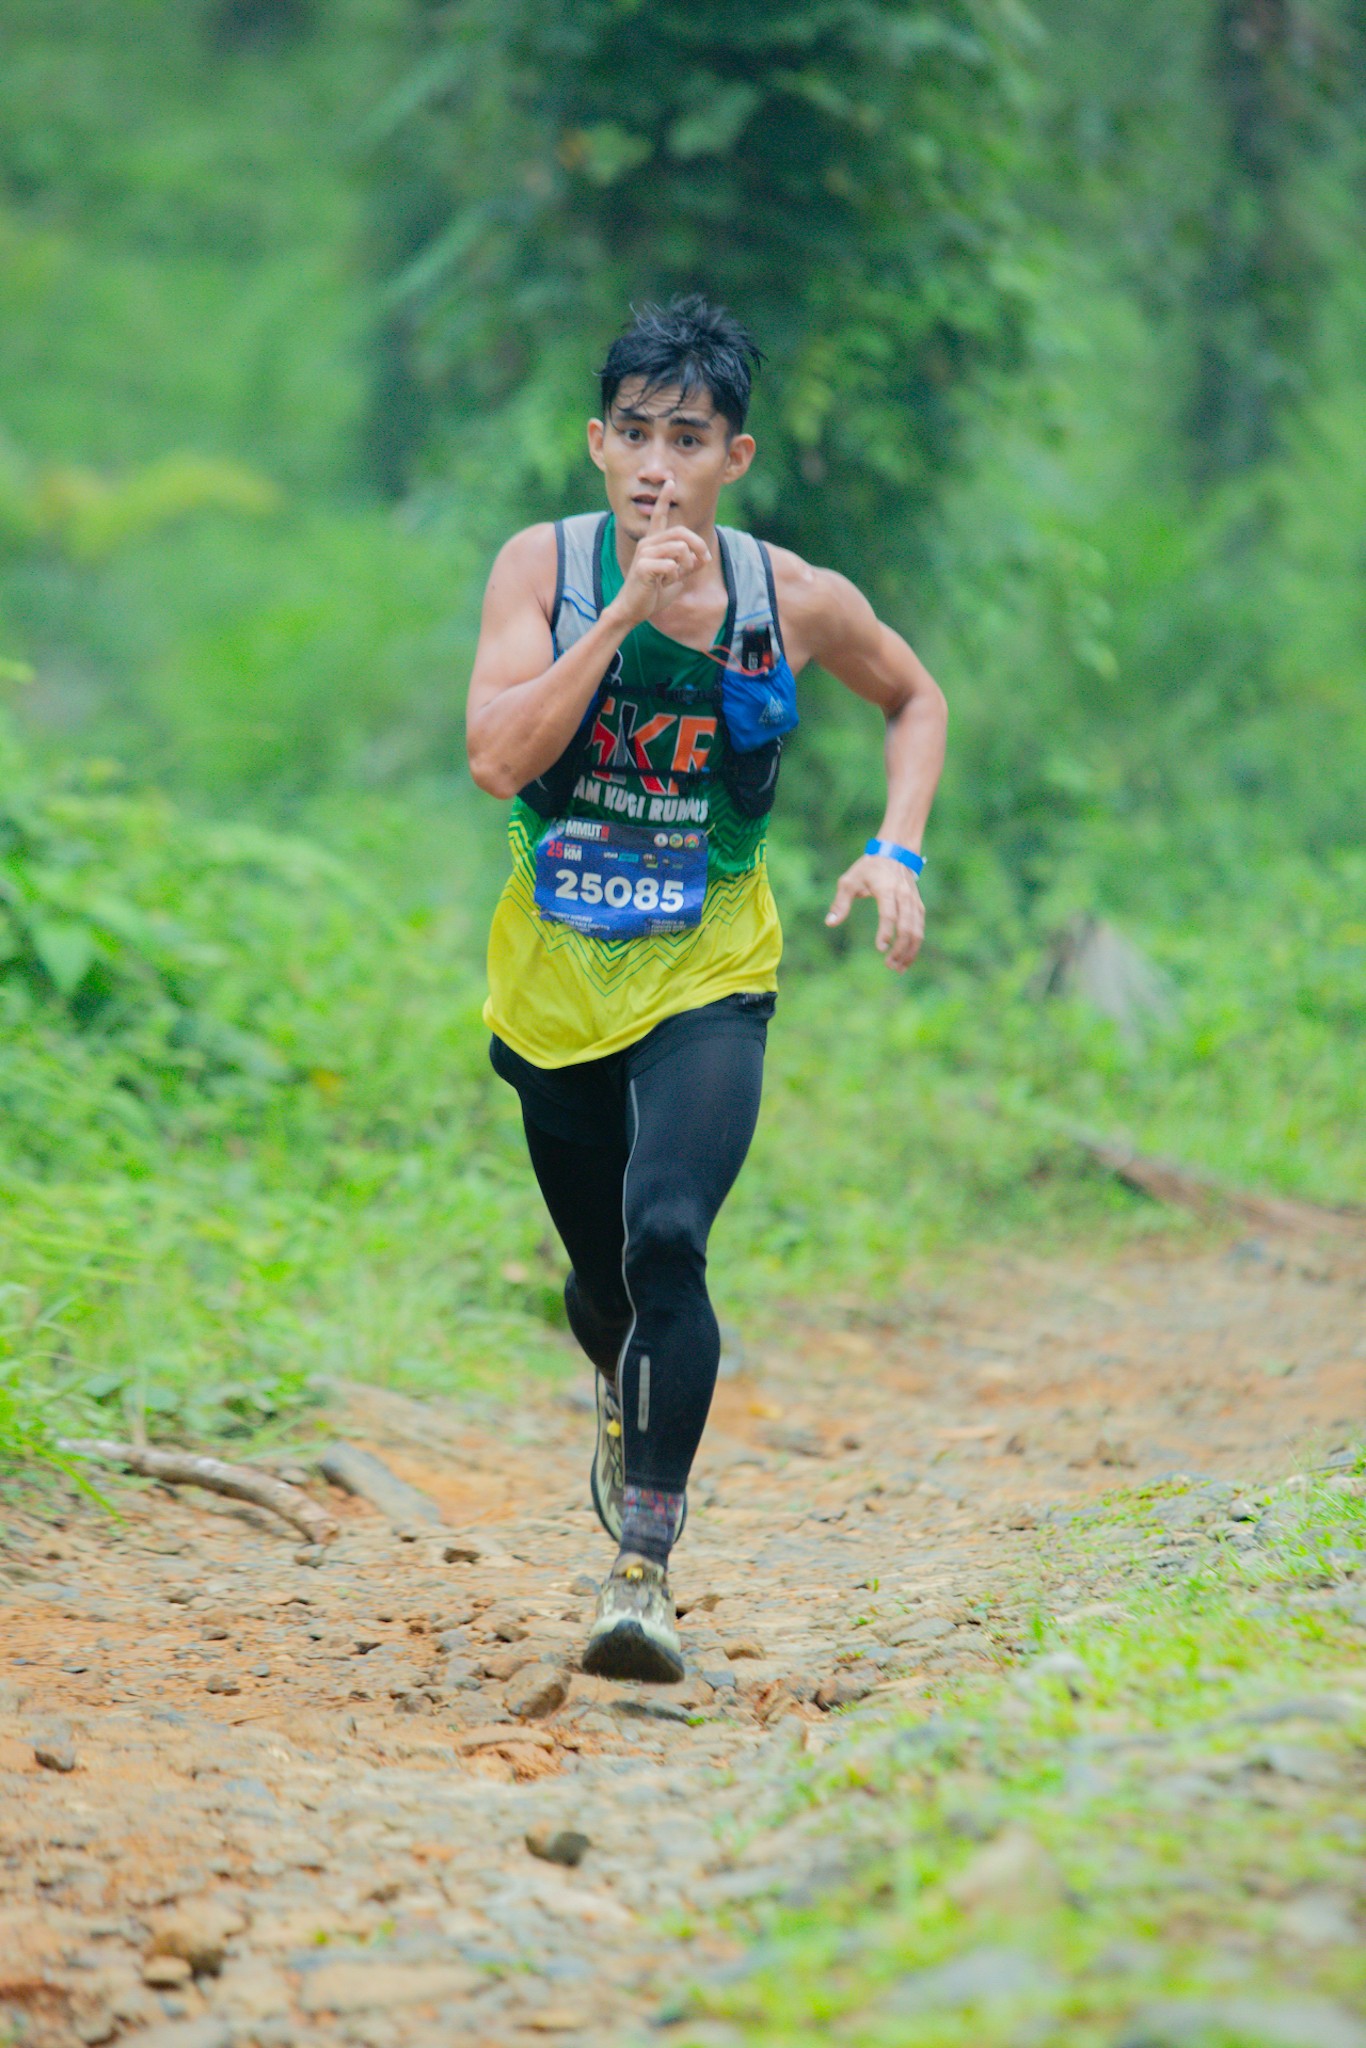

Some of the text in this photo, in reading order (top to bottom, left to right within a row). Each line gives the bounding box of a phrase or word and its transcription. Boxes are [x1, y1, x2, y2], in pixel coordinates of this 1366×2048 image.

[604, 784, 646, 819] KUGI
[547, 840, 563, 859] 25
[564, 847, 583, 862] KM
[555, 869, 685, 914] 25085
